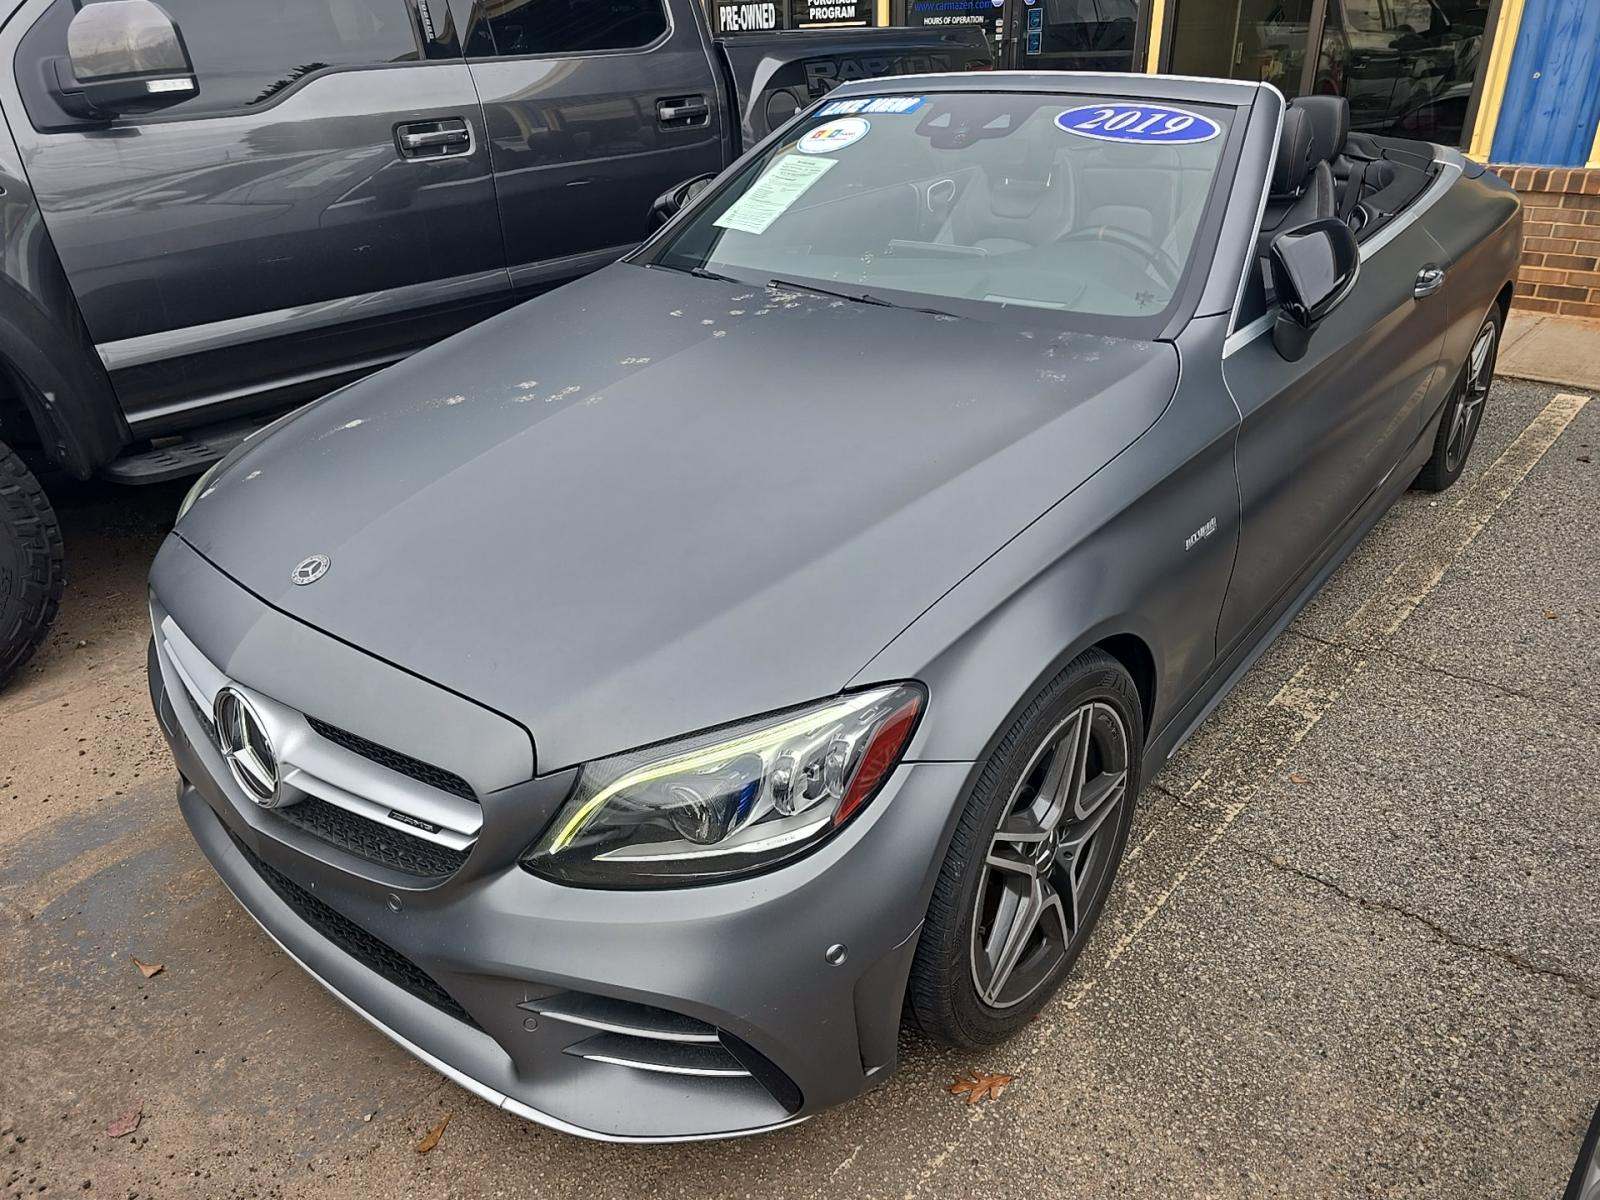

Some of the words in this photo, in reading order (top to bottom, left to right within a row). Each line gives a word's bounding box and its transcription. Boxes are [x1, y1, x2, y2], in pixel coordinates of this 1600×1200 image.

[719, 3, 776, 32] PRE-OWNED
[810, 6, 856, 20] PROGRAM
[923, 17, 943, 26] HOURS
[943, 17, 952, 25] OF
[952, 15, 985, 25] OPERATION
[1073, 109, 1195, 135] 2019
